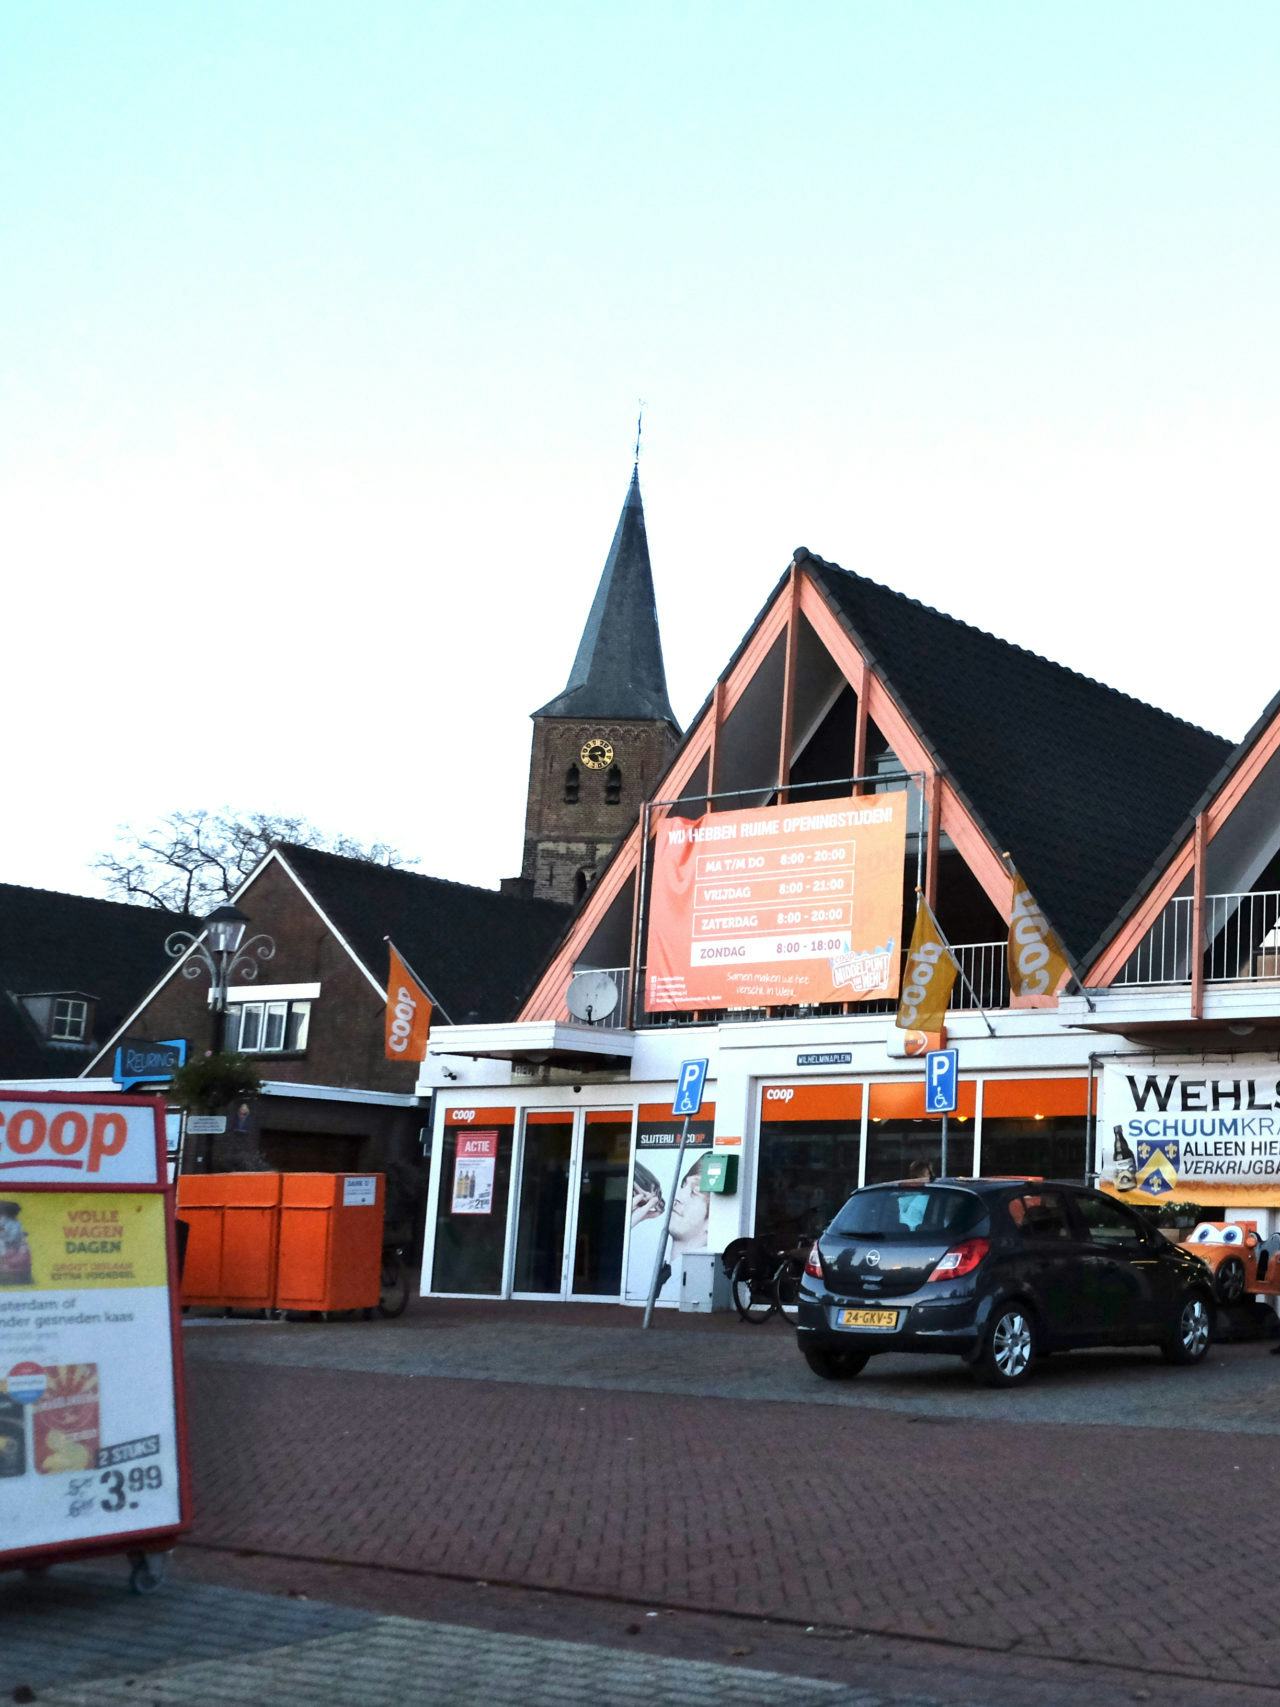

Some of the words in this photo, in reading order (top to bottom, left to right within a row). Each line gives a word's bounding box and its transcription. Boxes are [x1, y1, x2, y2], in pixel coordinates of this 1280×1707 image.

[688, 824, 737, 842] HEBBEN
[740, 819, 779, 838] RUIME
[705, 860, 722, 872] MA
[724, 858, 745, 871] T/M
[748, 856, 765, 868] DO
[780, 852, 805, 865] 8:00
[813, 848, 846, 862] 20:00
[703, 886, 751, 901] VRIJDAG
[779, 881, 804, 895] 8:00
[812, 878, 844, 892] 21:00
[701, 915, 759, 931] ZATERDAG
[776, 911, 801, 925] 8:00
[810, 907, 843, 921] 20:00
[700, 945, 746, 960] ZONDAG
[776, 942, 800, 954] 8:00
[811, 938, 841, 952] 18:00
[389, 986, 417, 1053] coop
[681, 1065, 699, 1092] P
[932, 1056, 950, 1086] P
[766, 1087, 794, 1103] coop
[452, 1109, 475, 1123] coop
[465, 1140, 490, 1152] ACTIE
[1183, 1140, 1245, 1157] ALLEEN
[67, 1209, 120, 1224] VOLLE
[63, 1225, 125, 1239] WAGEN
[65, 1241, 123, 1255] DAGEN
[34, 1313, 103, 1329] gesneden
[104, 1311, 135, 1323] kaas
[846, 1312, 894, 1325] 24-GKV-5
[98, 1450, 109, 1466] 2
[111, 1437, 157, 1462] STUKS
[100, 1464, 162, 1513] 3.99
